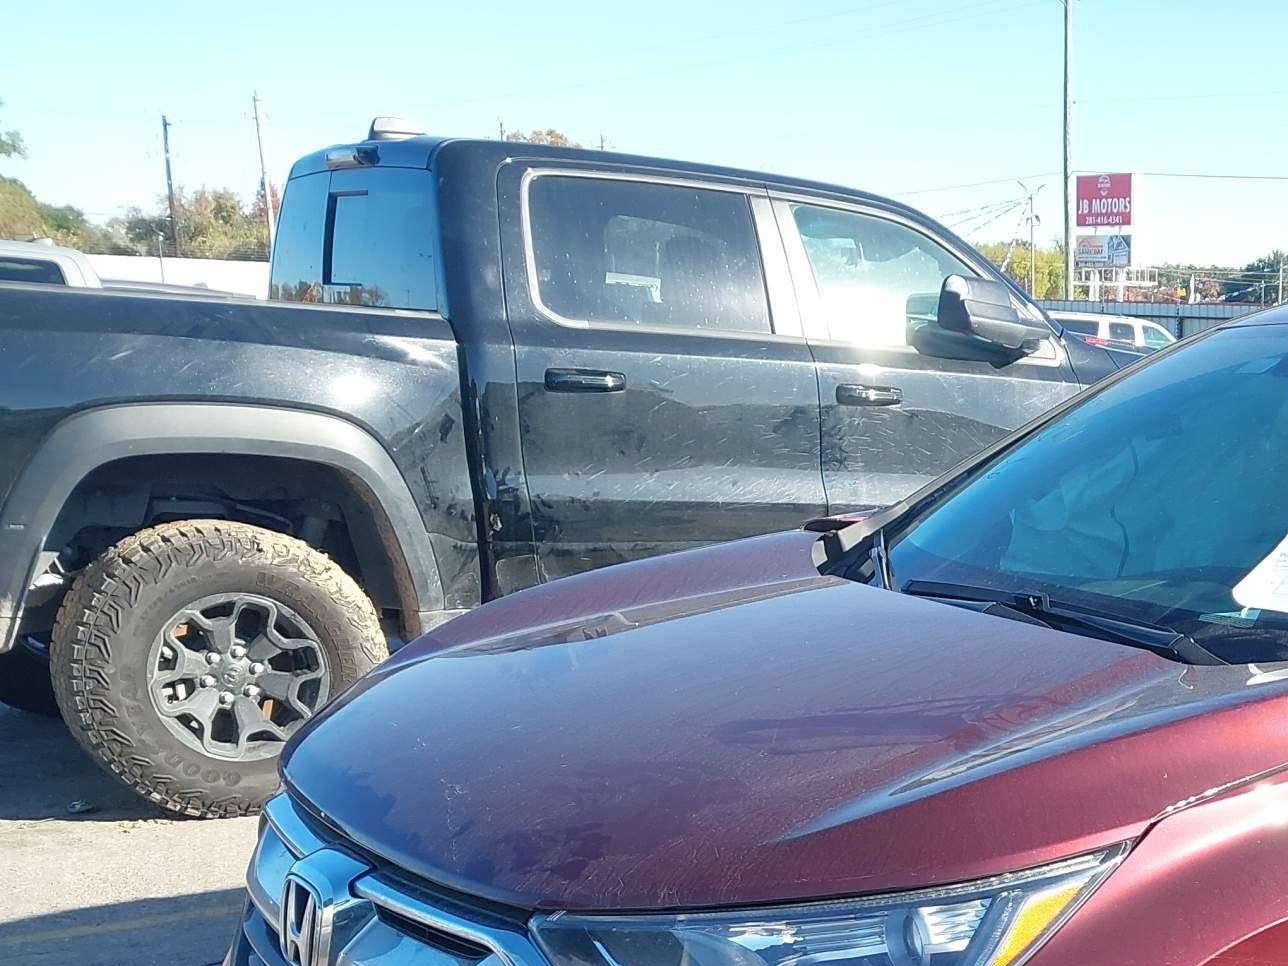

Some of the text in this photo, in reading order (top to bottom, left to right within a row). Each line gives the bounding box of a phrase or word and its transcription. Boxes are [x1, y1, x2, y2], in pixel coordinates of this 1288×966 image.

[1078, 197, 1130, 214] JB MOTORS
[1086, 215, 1122, 224] 281-416-4341
